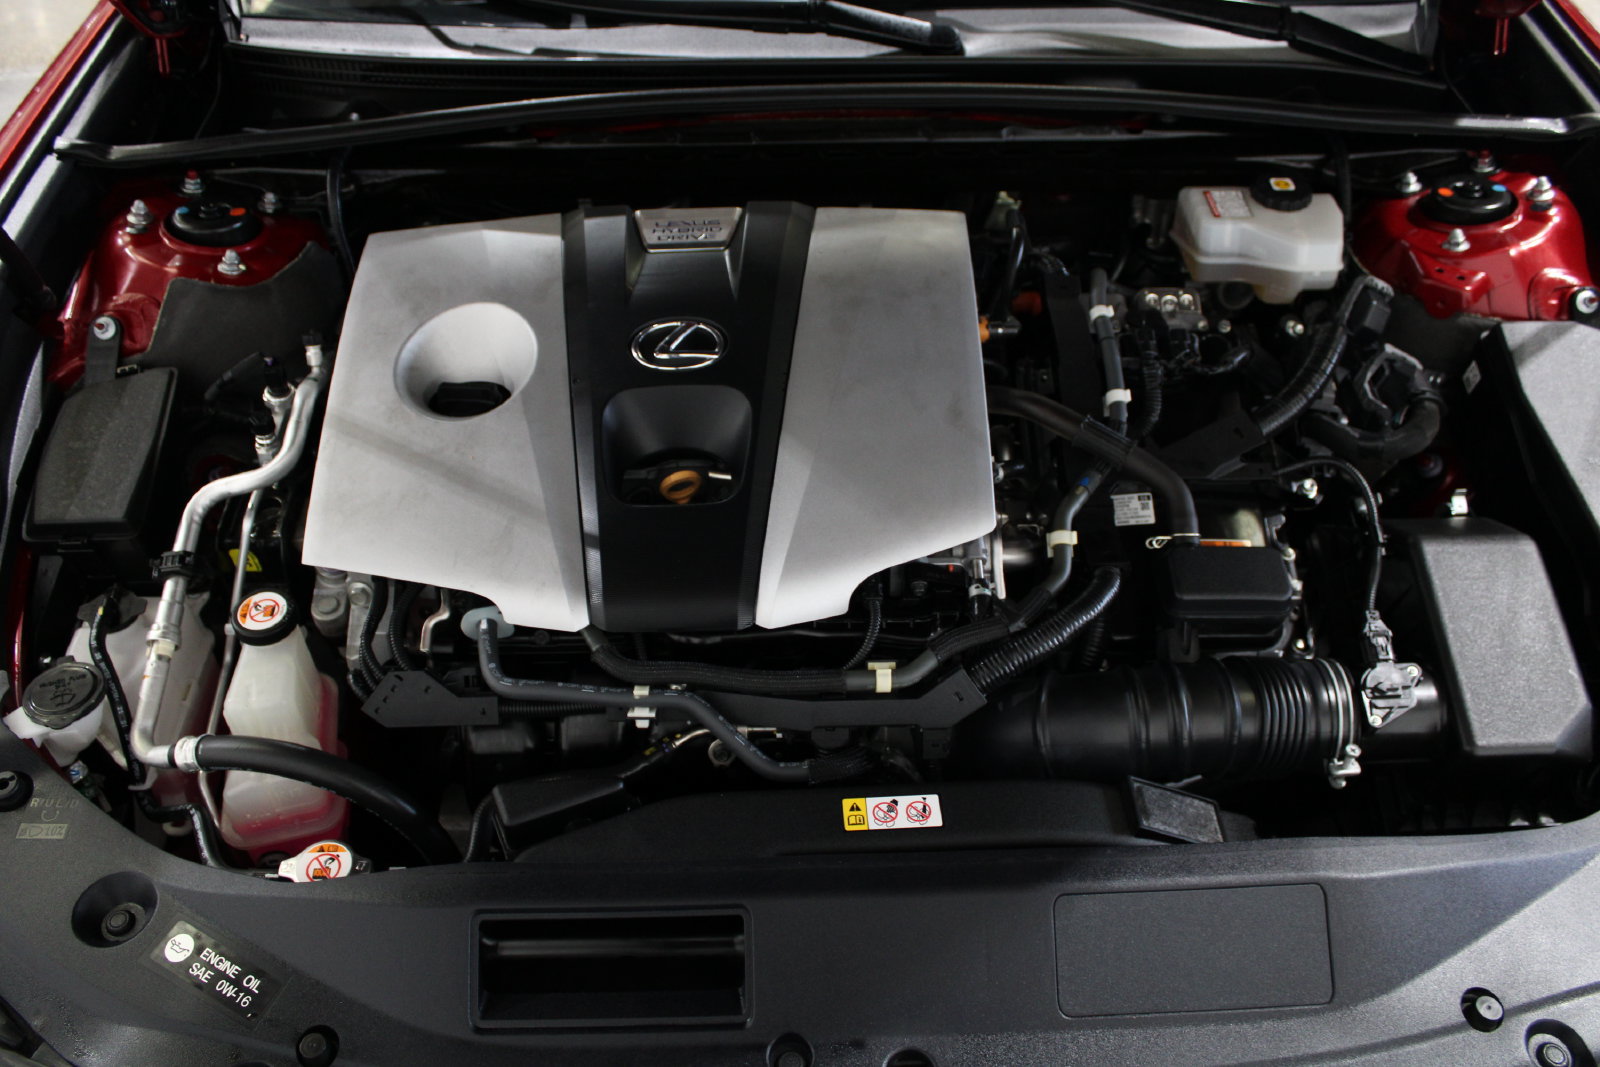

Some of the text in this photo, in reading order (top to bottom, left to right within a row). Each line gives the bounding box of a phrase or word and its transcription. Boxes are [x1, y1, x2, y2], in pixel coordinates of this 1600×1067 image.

[188, 962, 252, 1008] SAE 0W-16
[200, 947, 261, 994] ENGINE OIL
